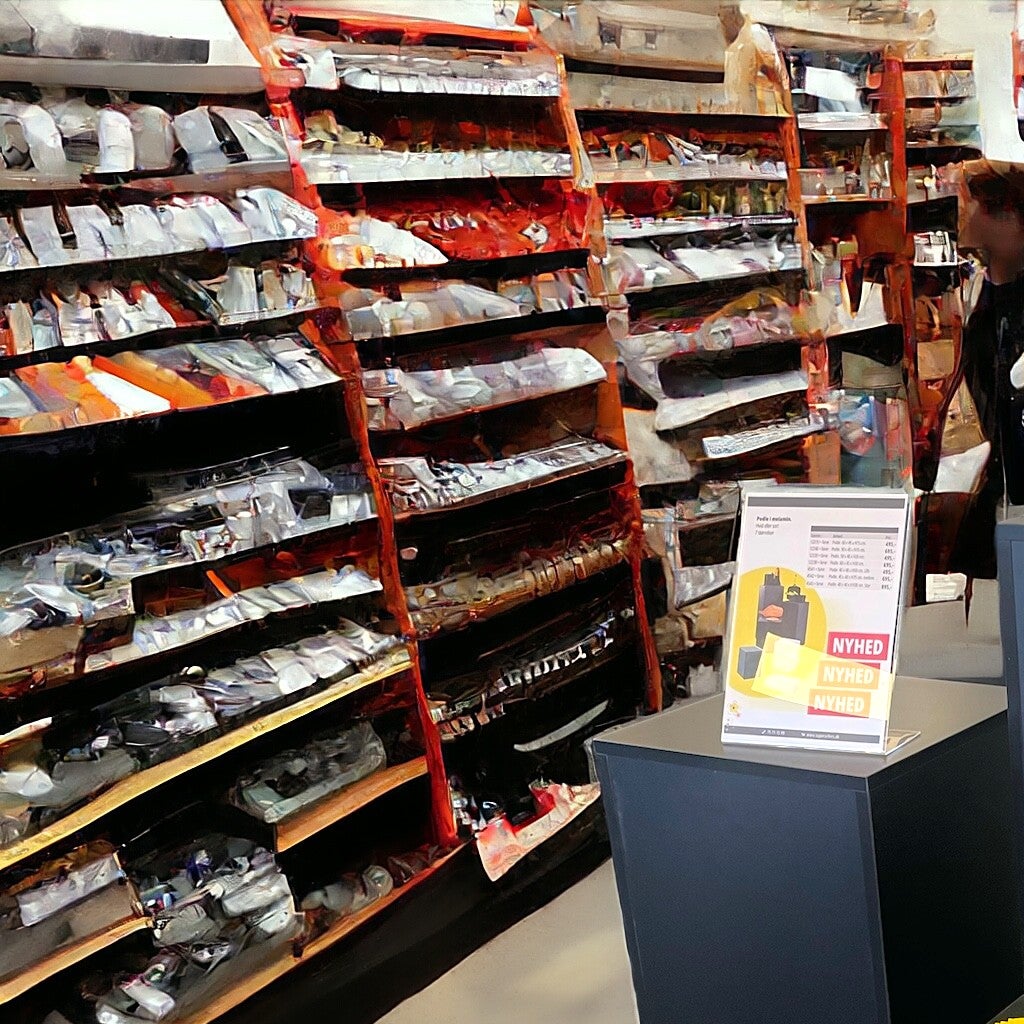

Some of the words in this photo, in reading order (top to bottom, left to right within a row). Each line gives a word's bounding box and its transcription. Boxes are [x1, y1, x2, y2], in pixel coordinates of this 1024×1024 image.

[833, 637, 884, 656] NYHED
[823, 666, 874, 685] NYHED
[814, 695, 865, 713] NYHED
